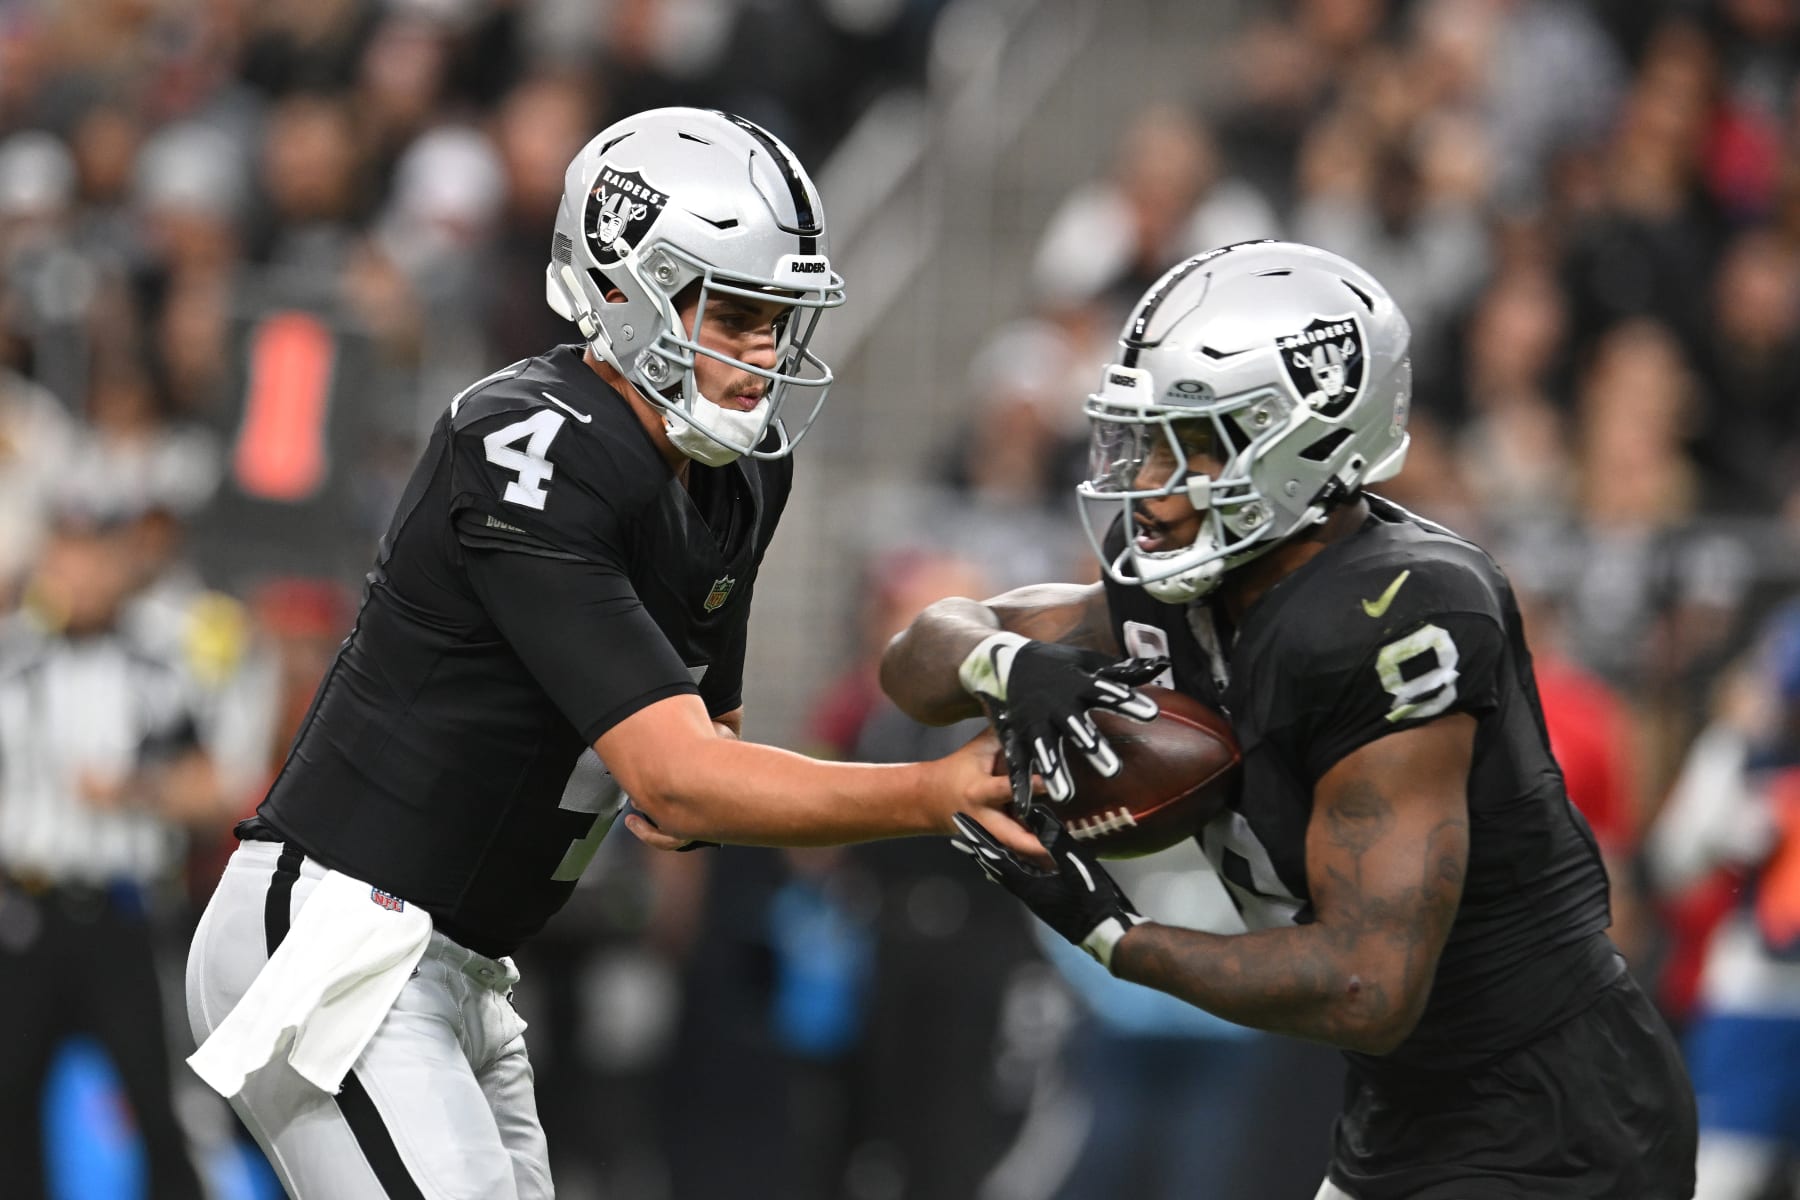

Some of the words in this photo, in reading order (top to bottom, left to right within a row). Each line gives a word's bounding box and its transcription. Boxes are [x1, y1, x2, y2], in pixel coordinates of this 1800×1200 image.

[603, 170, 661, 204] RAIDERS
[791, 261, 826, 273] RAIDERS
[483, 409, 566, 511] 4
[1375, 624, 1461, 723] 8
[373, 891, 401, 911] NFL
